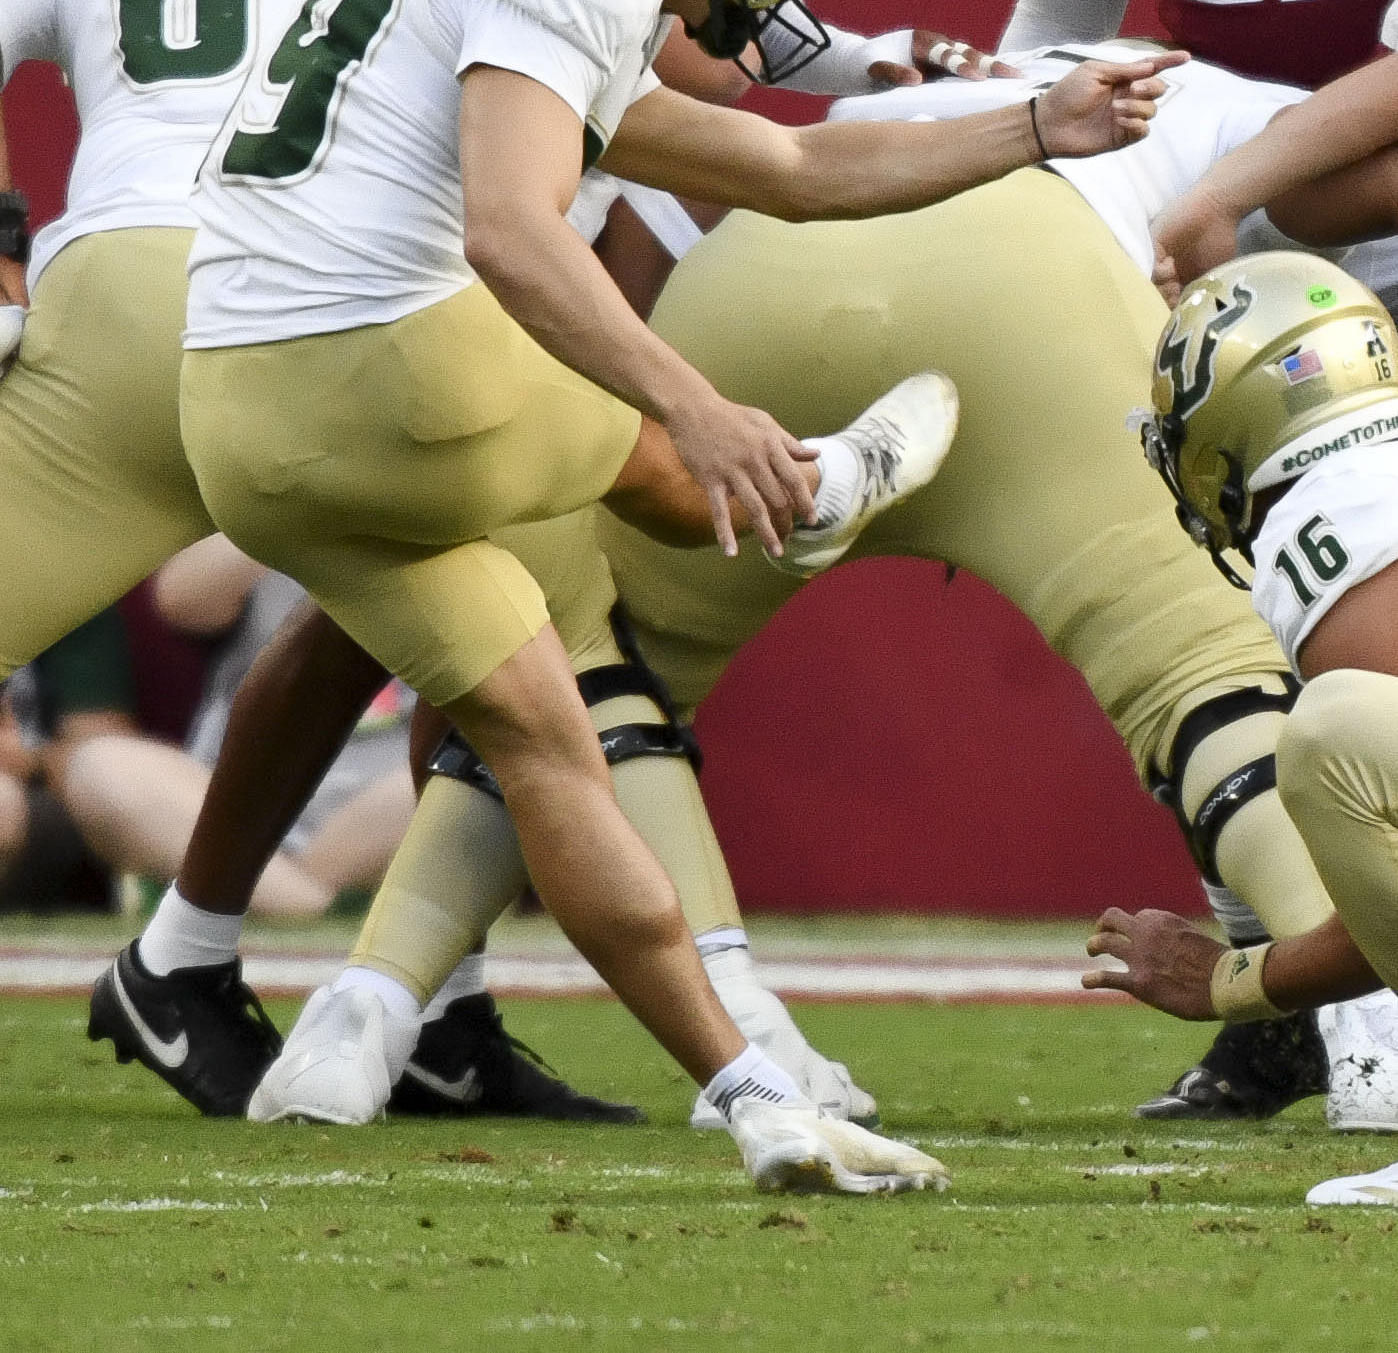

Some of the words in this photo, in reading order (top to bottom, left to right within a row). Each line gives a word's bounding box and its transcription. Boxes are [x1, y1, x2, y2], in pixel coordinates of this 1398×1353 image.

[1373, 358, 1392, 382] 16
[1273, 514, 1351, 608] 16
[1199, 767, 1257, 827] DONJOY
